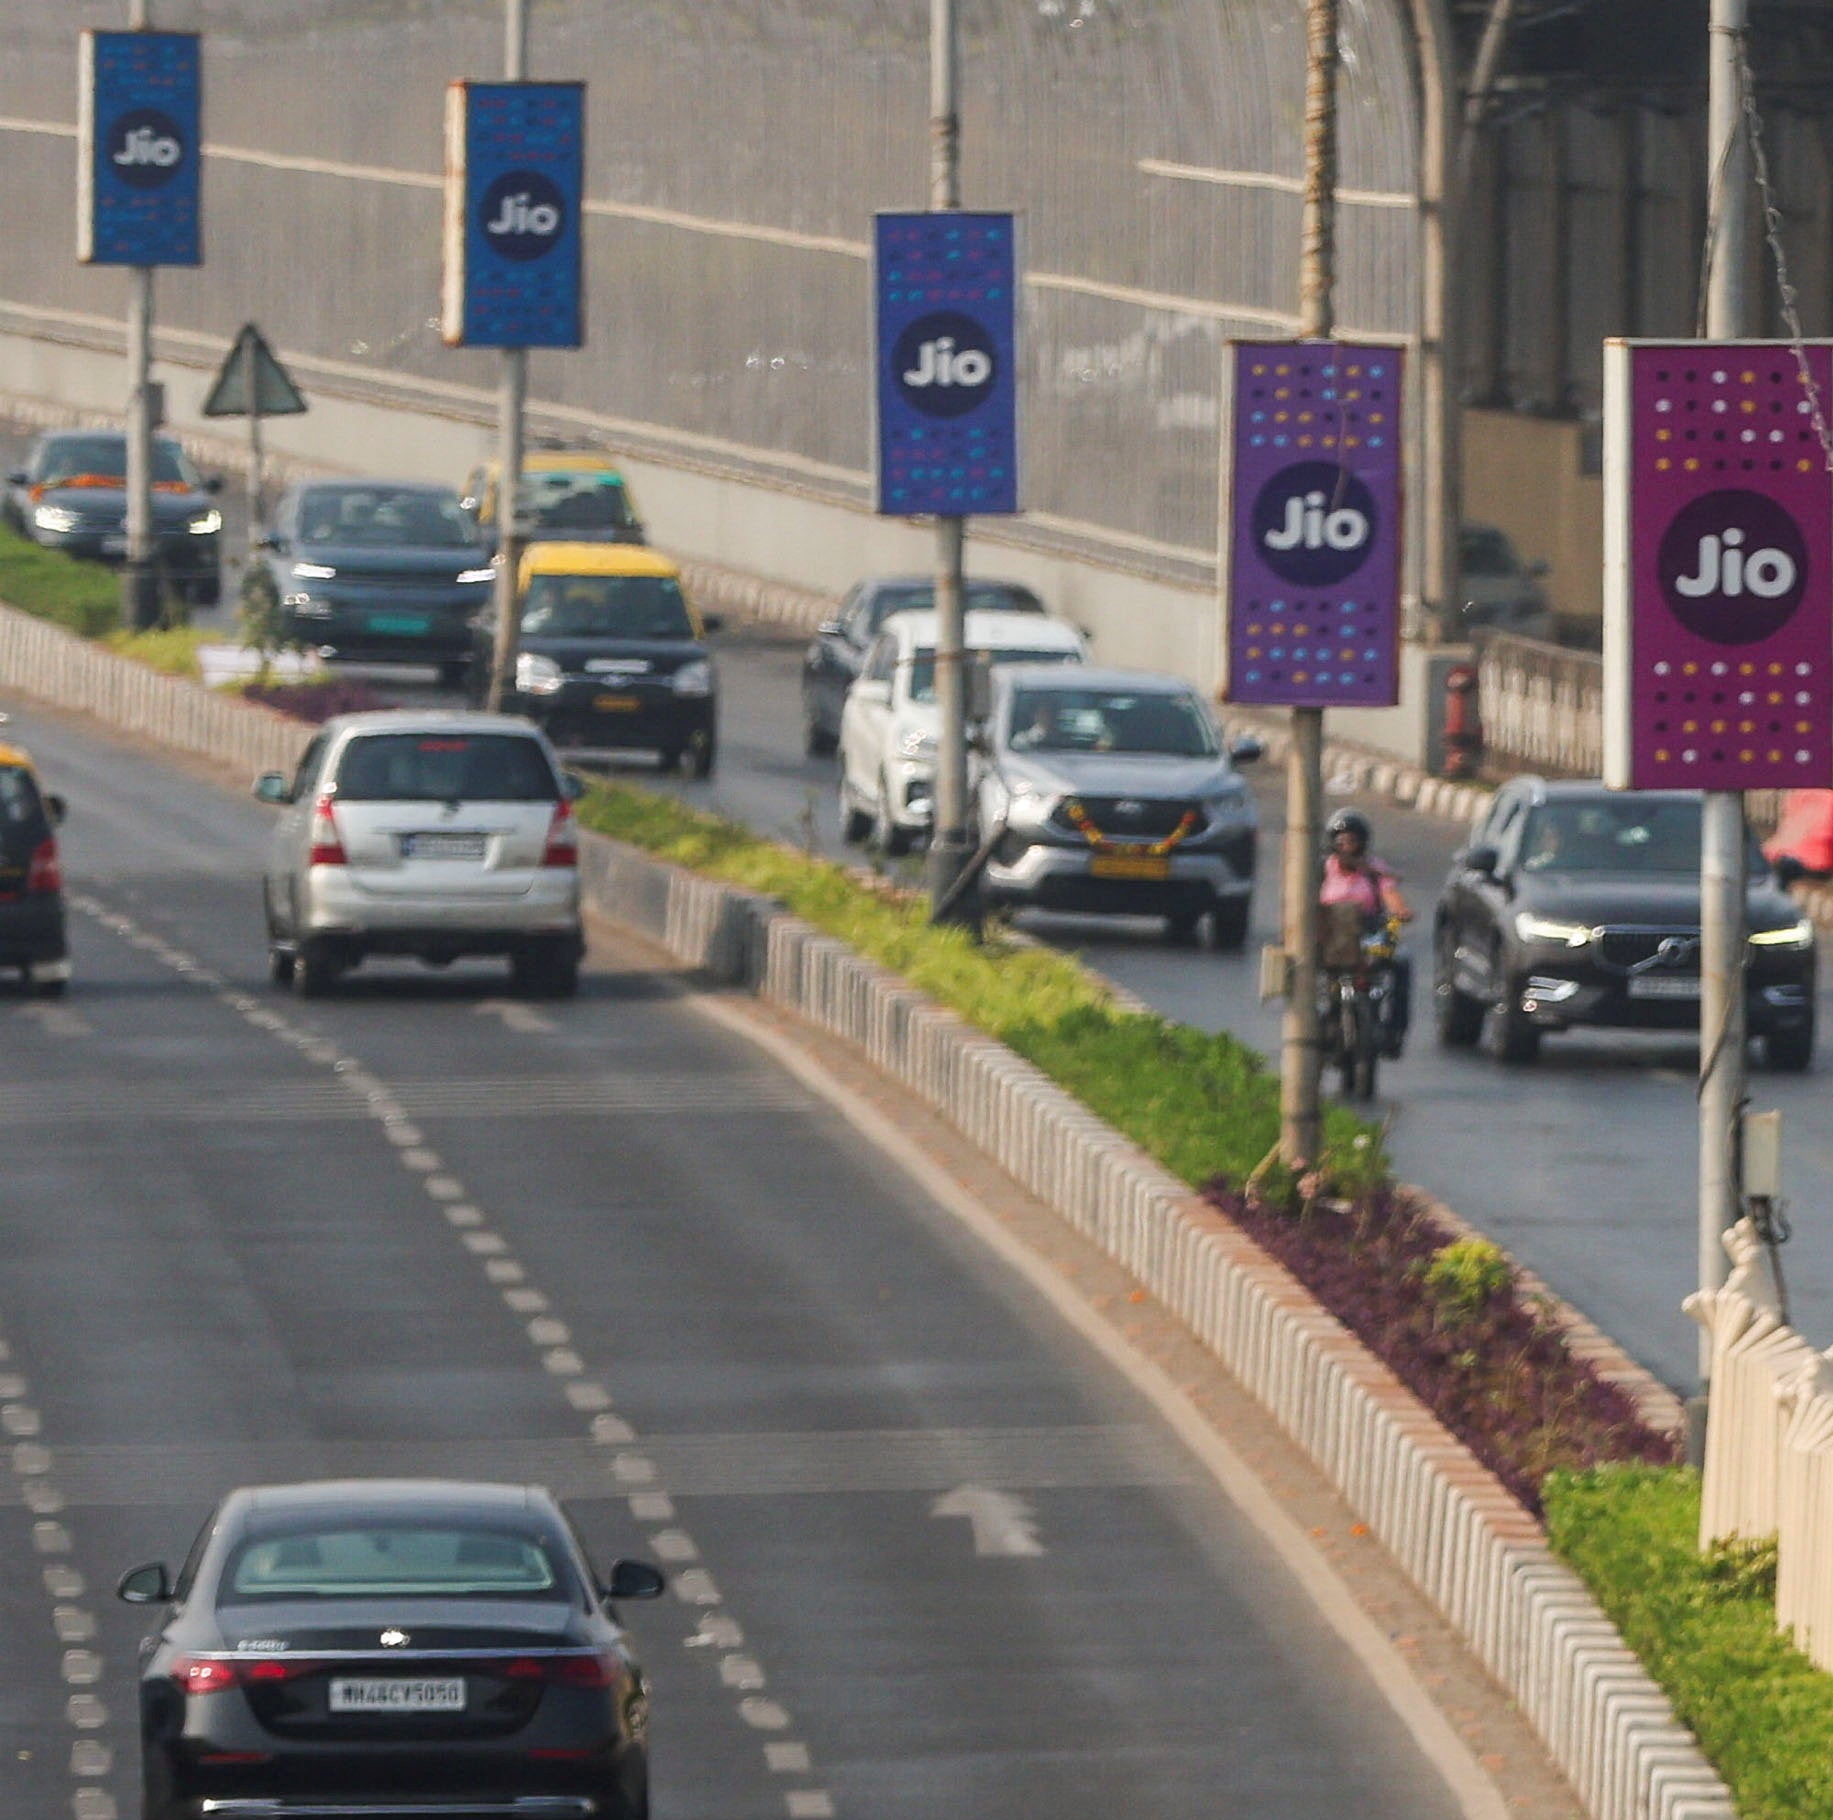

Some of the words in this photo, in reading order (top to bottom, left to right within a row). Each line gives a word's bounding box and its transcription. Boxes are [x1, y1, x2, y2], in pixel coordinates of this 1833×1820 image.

[114, 127, 180, 167] Jio
[487, 192, 558, 236] Jio
[903, 336, 991, 387] Jio
[1265, 491, 1368, 550] Jio
[1675, 527, 1796, 599] Jio
